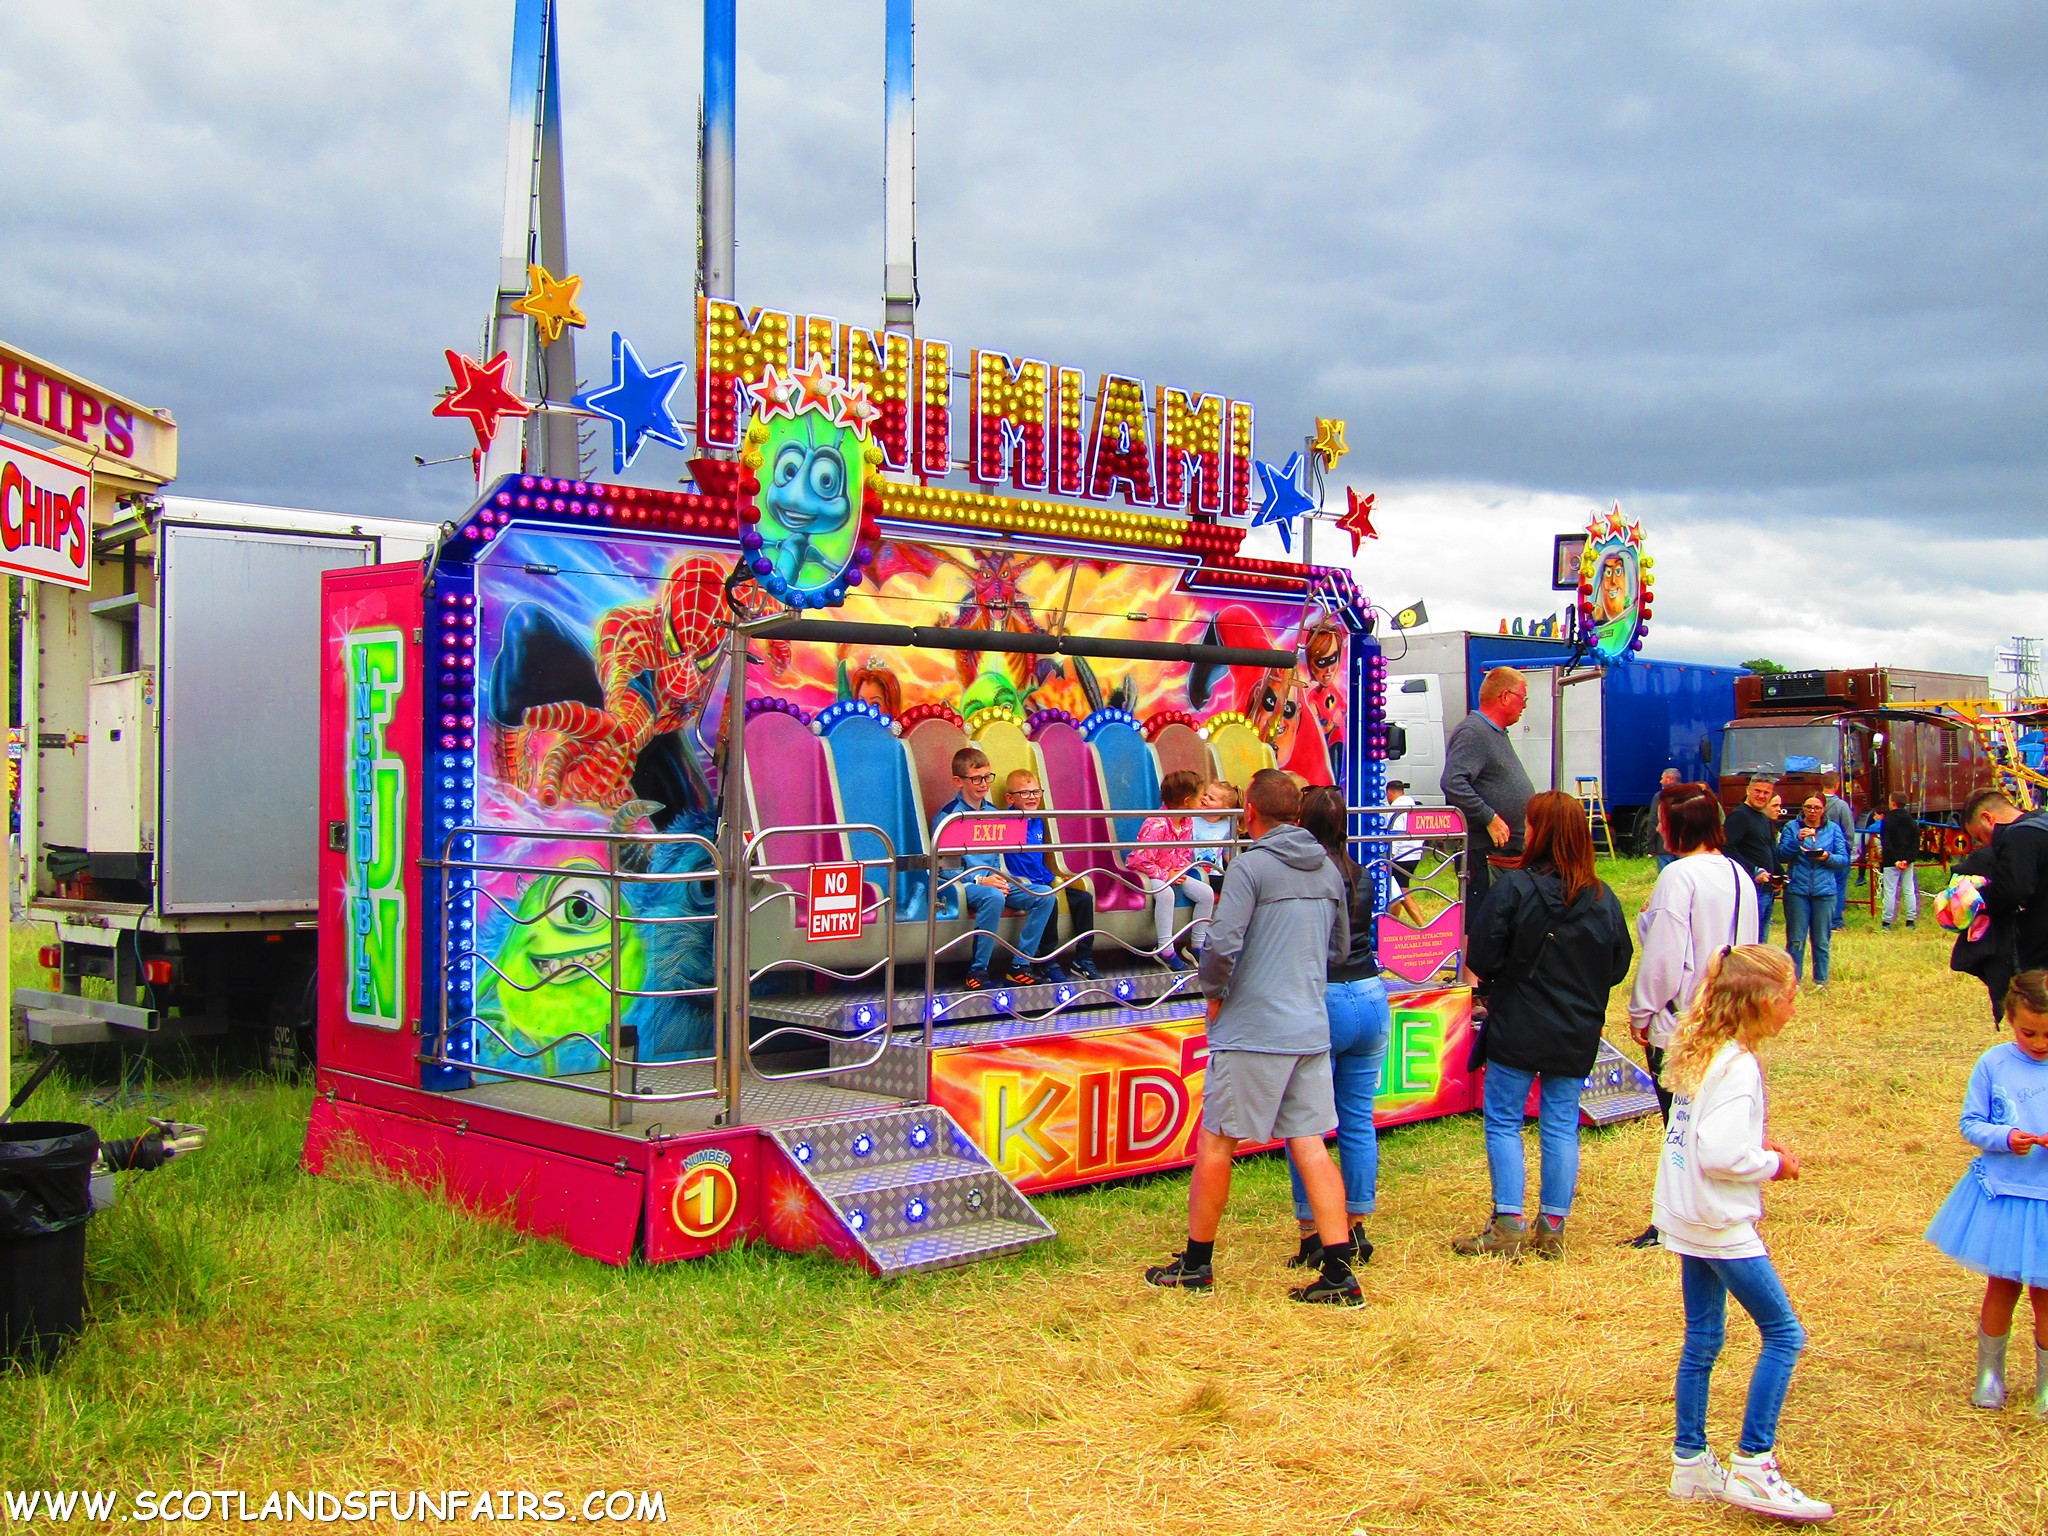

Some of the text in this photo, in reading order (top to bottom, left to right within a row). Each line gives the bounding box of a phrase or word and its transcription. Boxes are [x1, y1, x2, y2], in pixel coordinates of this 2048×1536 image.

[970, 349, 1254, 521] MIAMI
[1, 460, 86, 569] CHIPS
[1775, 673, 1813, 681] CARRIER
[345, 630, 405, 1030] FUN
[355, 647, 373, 1008] INCREDIBLE
[972, 824, 1006, 841] EXIT
[1415, 815, 1451, 829] ENTRANCE
[824, 872, 847, 894] NO
[813, 912, 857, 933] ENTRY
[682, 1149, 732, 1172] NUMBER
[683, 1175, 714, 1226] 1
